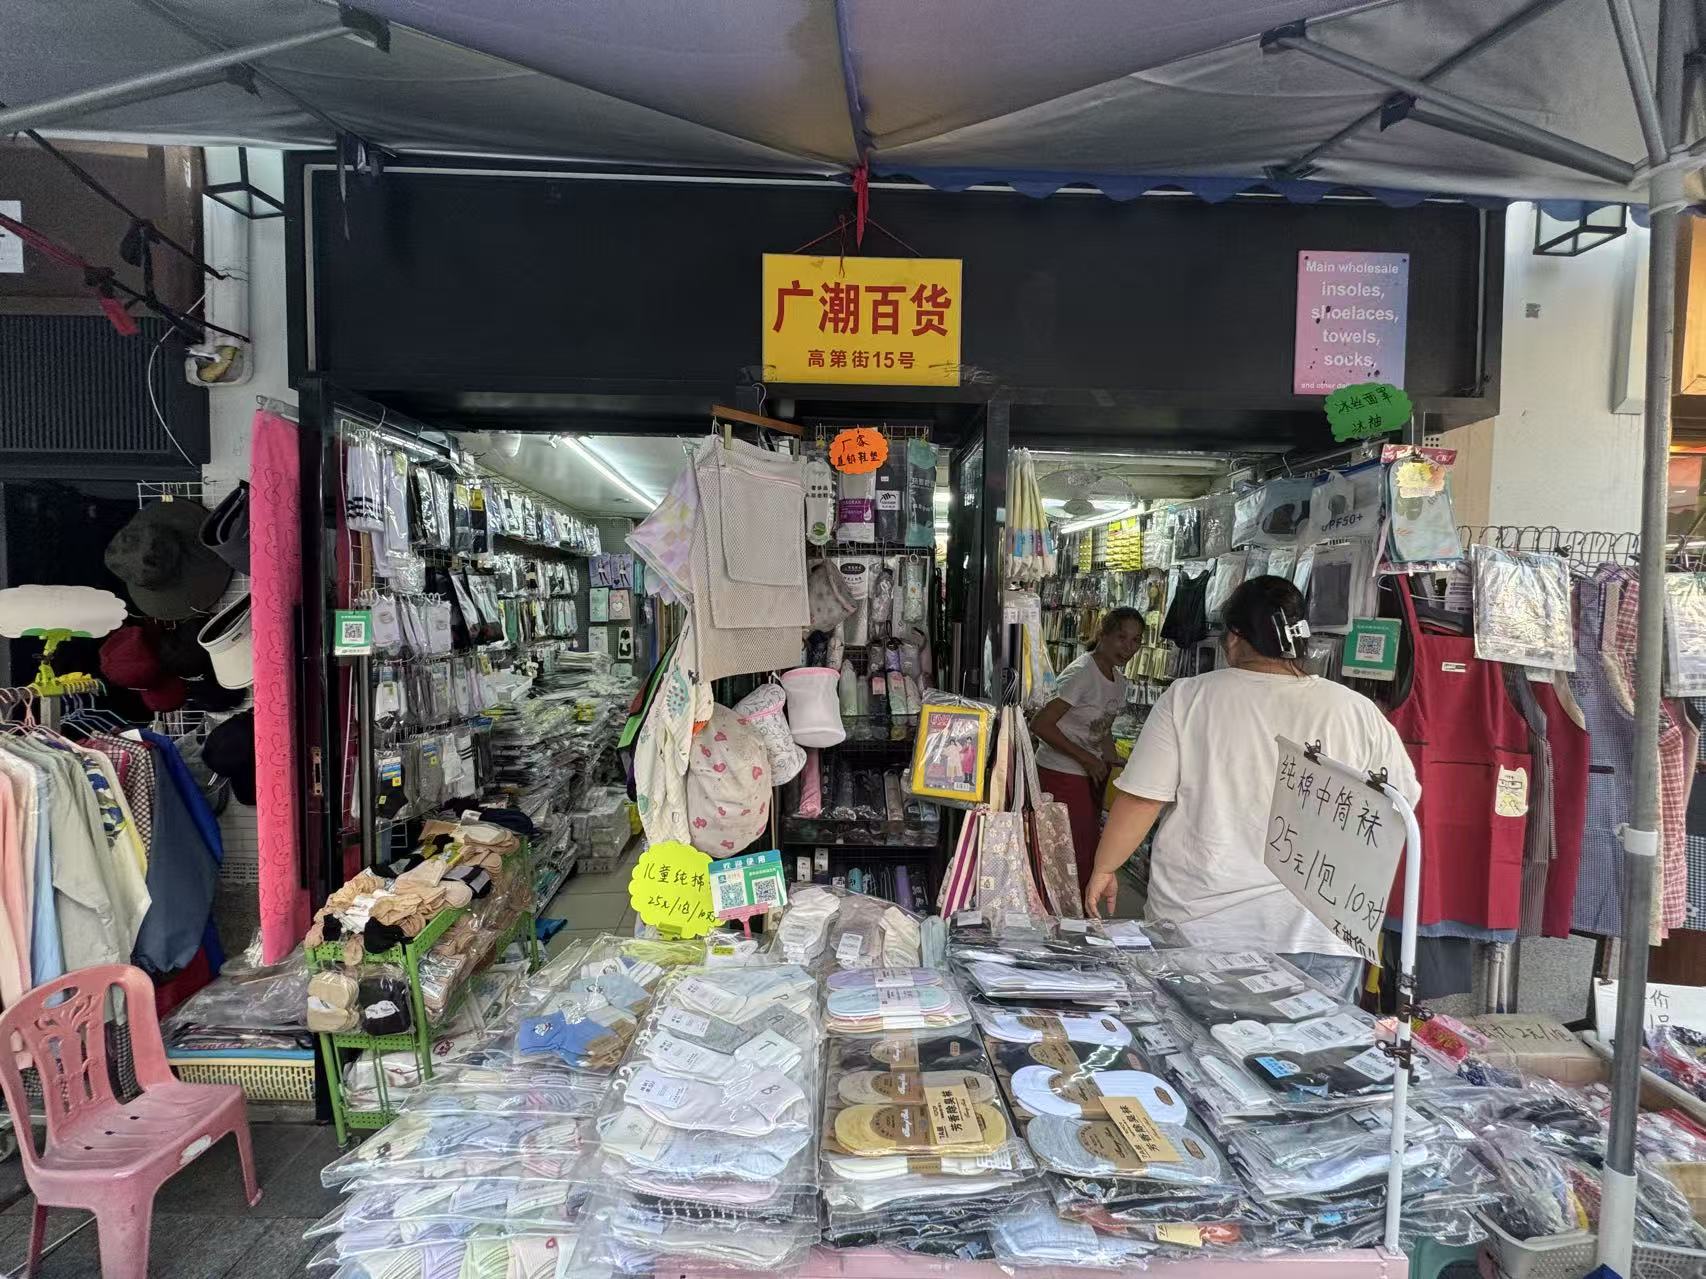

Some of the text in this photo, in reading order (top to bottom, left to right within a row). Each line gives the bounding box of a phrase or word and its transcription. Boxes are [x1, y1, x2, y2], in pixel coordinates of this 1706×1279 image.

[1305, 261, 1399, 274] Main wholesale
[1321, 281, 1385, 299] insoles,
[772, 279, 952, 337] 广潮百货
[1311, 305, 1399, 324] shoelaces,
[1323, 329, 1381, 346] towels,
[808, 350, 916, 369] 高第街15号
[1323, 353, 1378, 369] socks,
[1301, 381, 1315, 389] and
[841, 434, 870, 453] 厂家
[1279, 755, 1382, 849] 纯棉中筒袜
[643, 862, 712, 892] 儿童纯棉
[1344, 883, 1385, 932] 10对
[941, 1089, 964, 1132] 芳香除臭袜
